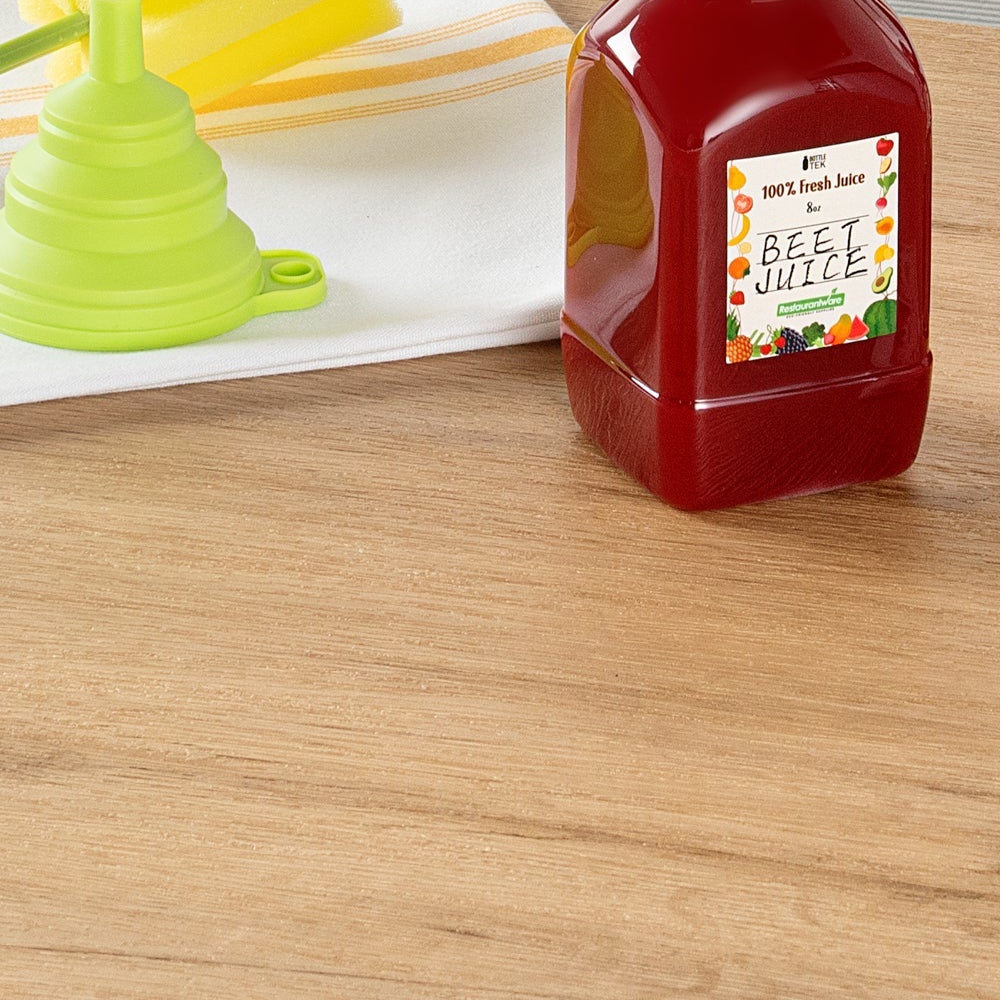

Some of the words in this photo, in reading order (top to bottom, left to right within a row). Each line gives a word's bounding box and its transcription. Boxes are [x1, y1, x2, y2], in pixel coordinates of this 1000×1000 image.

[810, 160, 826, 170] TEK
[762, 181, 796, 200] 100%
[800, 175, 831, 195] Fresh
[834, 171, 865, 188] Juice
[806, 201, 821, 214] 8oz
[761, 219, 860, 266] BEET
[755, 247, 868, 294] JUICE
[779, 296, 842, 313] Restaurantware
